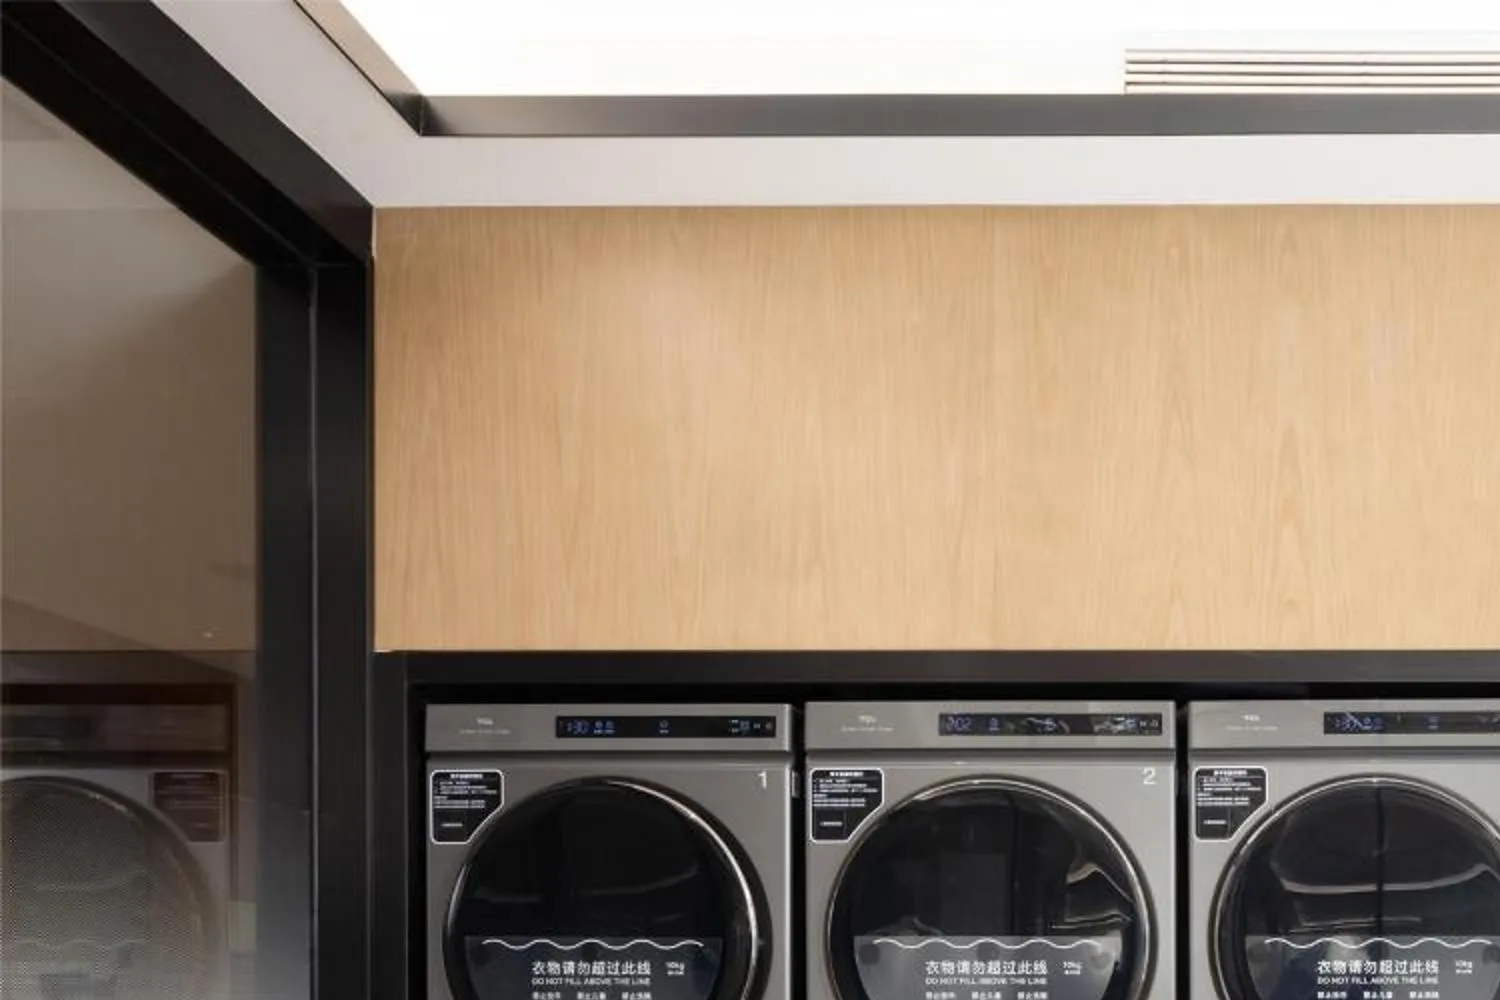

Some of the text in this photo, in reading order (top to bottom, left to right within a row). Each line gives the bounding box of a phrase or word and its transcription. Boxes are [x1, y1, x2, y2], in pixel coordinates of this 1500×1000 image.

[758, 771, 768, 788] 1
[1142, 767, 1156, 785] 2
[532, 960, 650, 976] 衣物请勿超过此线
[926, 960, 1048, 975] 衣物请勿超过此线
[1318, 960, 1439, 974] 衣物请勿超过此线
